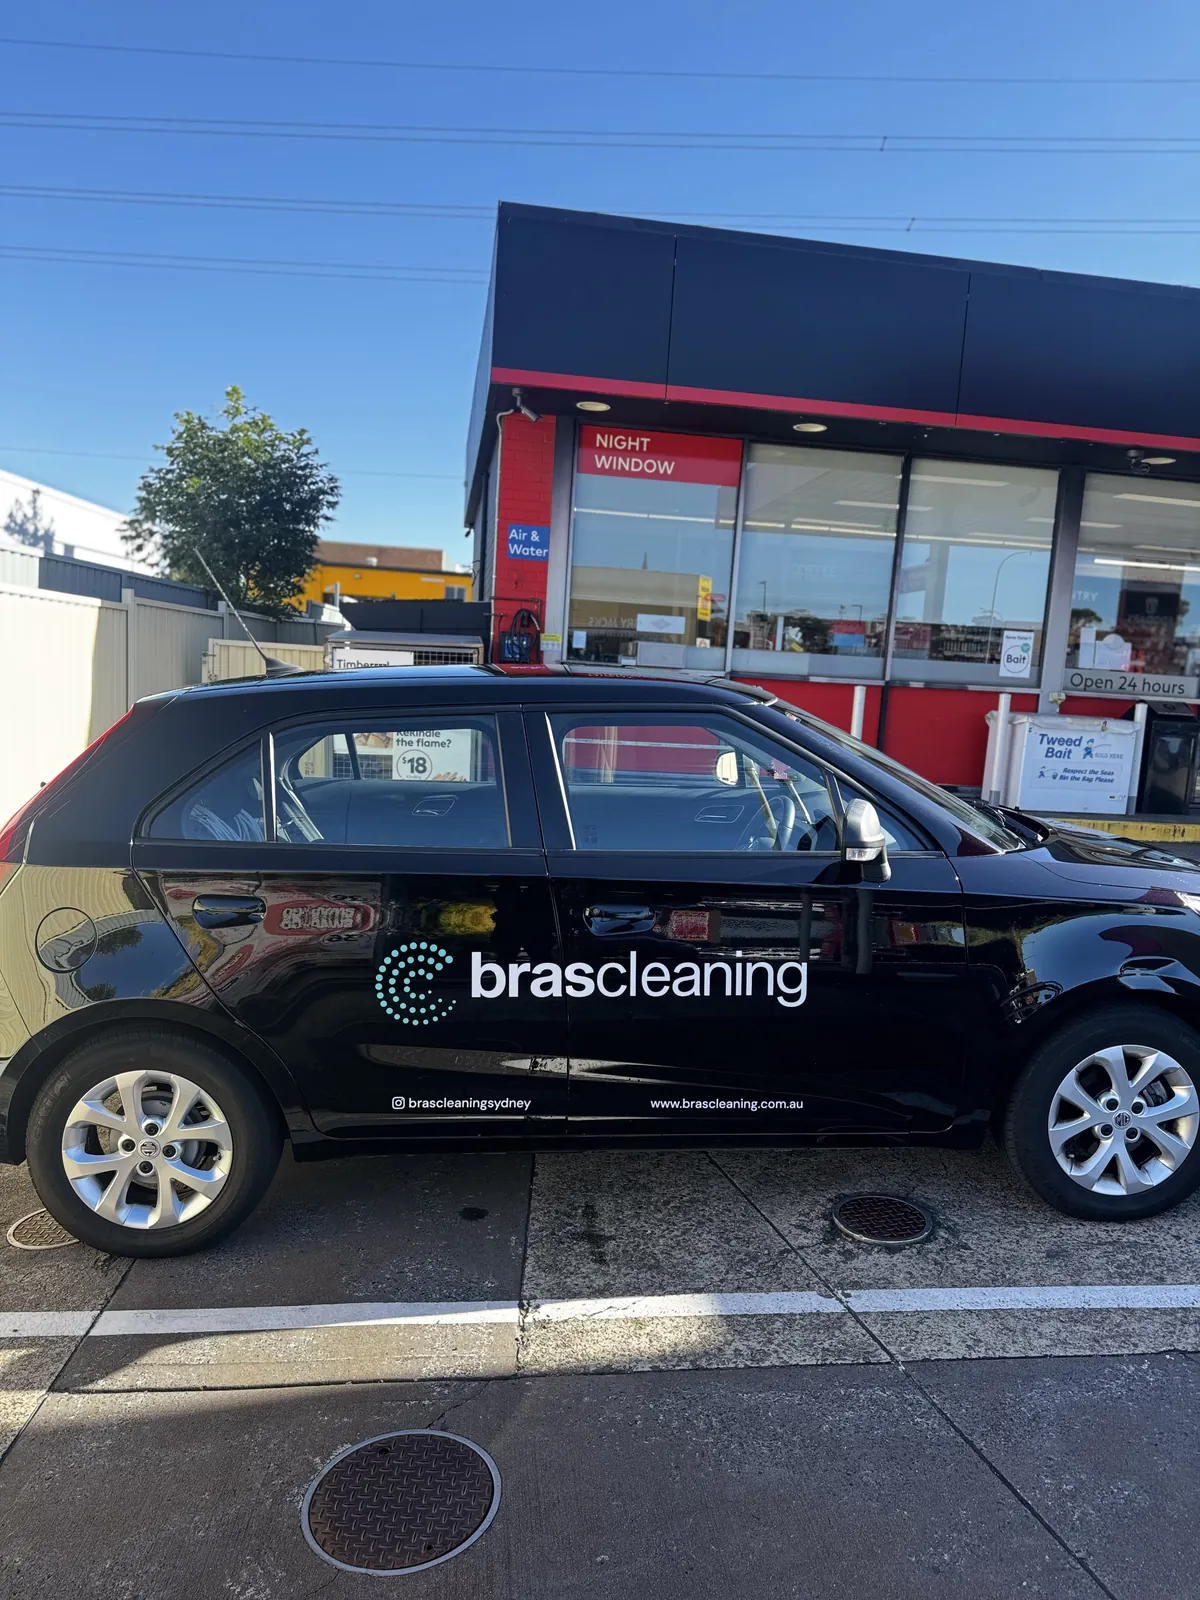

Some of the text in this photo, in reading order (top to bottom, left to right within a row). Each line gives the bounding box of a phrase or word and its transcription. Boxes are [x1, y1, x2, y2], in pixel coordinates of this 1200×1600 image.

[596, 433, 651, 452] NIGHT
[594, 454, 675, 475] WINDOW
[508, 528, 541, 542] Air &
[508, 543, 549, 557] Water
[1006, 653, 1027, 665] Bait
[1070, 673, 1185, 695] Open 24 hours
[396, 737, 452, 748] the flame?
[1039, 733, 1083, 747] Tweed
[1045, 747, 1073, 760] Bait
[402, 756, 427, 774] $18
[1062, 767, 1088, 776] Respect
[1088, 768, 1099, 776] the
[1082, 775, 1094, 783] Bag
[1094, 776, 1115, 784] Please
[471, 950, 808, 1007] brascleaning
[408, 1097, 532, 1111] brascleaningsydney
[650, 1098, 804, 1112] www.brascleaning.com.au
